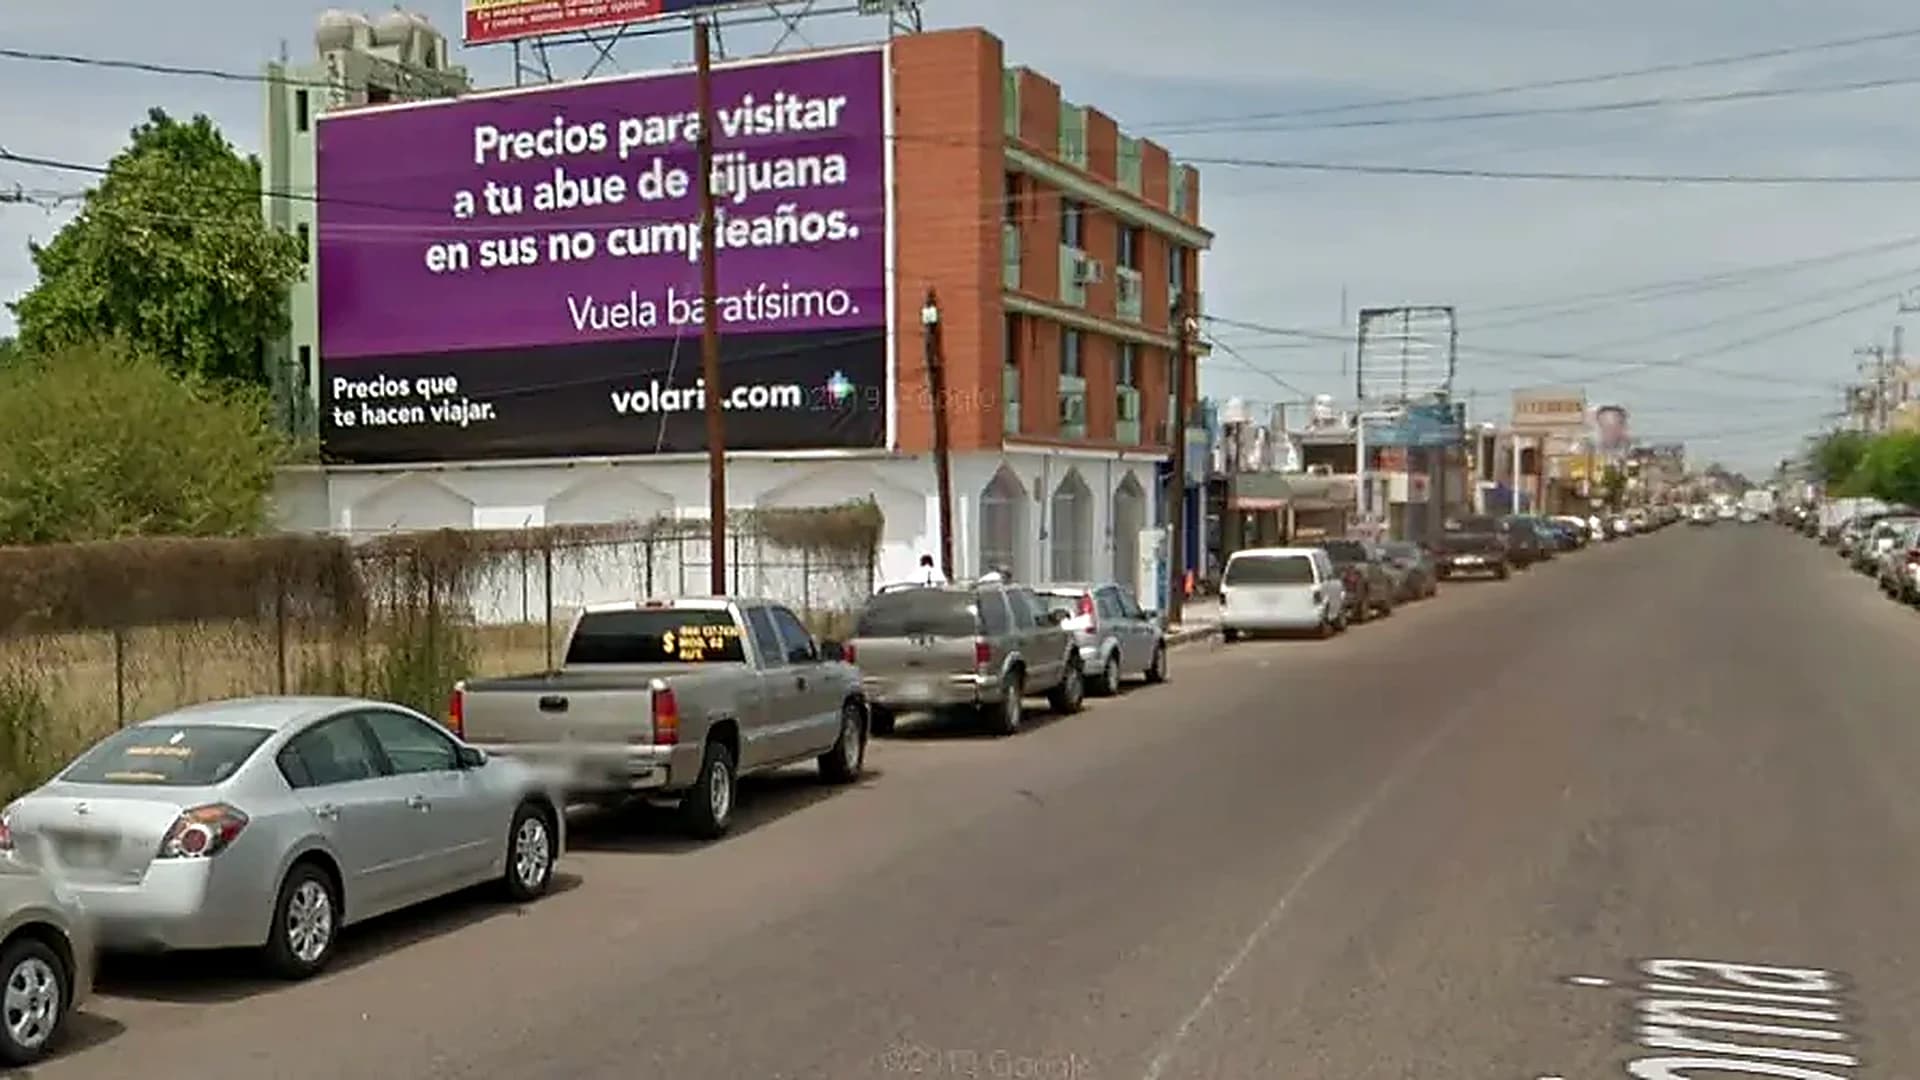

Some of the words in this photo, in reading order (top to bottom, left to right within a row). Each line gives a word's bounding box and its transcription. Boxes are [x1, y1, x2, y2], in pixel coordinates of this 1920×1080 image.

[474, 116, 608, 164] Precios
[618, 110, 704, 160] para
[717, 91, 847, 138] visitar
[453, 190, 475, 218] a
[483, 180, 523, 215] tu
[533, 166, 627, 211] abue
[638, 156, 690, 200] de
[425, 242, 470, 272] en
[479, 235, 539, 268] sus
[549, 230, 596, 262] no
[607, 203, 860, 262] cumpleaños.
[567, 290, 656, 331] Vuela
[333, 374, 411, 400] Precios
[415, 375, 459, 401] que
[611, 378, 801, 414] volari.com
[332, 406, 356, 427] te
[361, 402, 425, 426] hacen
[430, 397, 497, 428] viajar.
